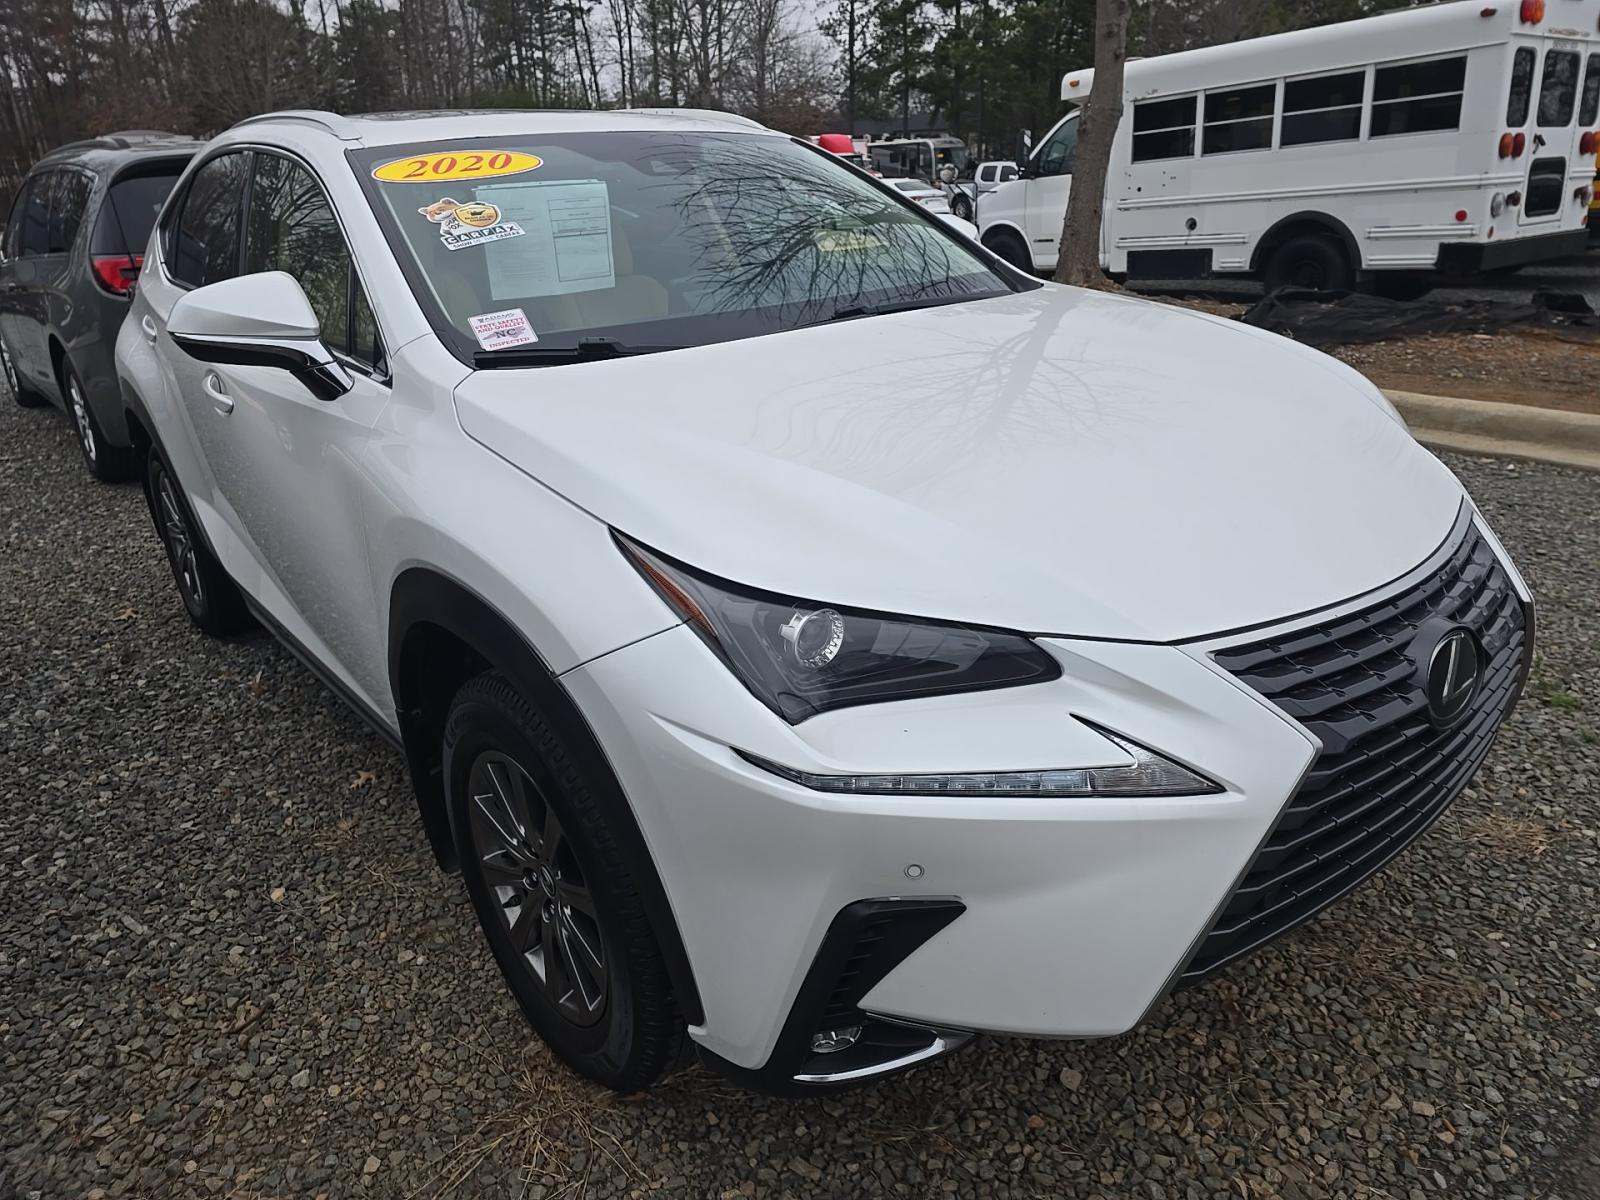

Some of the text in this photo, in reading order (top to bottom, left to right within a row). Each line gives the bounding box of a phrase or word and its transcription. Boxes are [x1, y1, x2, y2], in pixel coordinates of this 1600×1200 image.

[404, 153, 512, 178] 2020
[446, 226, 517, 244] CARFAX
[495, 328, 517, 338] NC
[489, 336, 530, 348] INSPECTED
